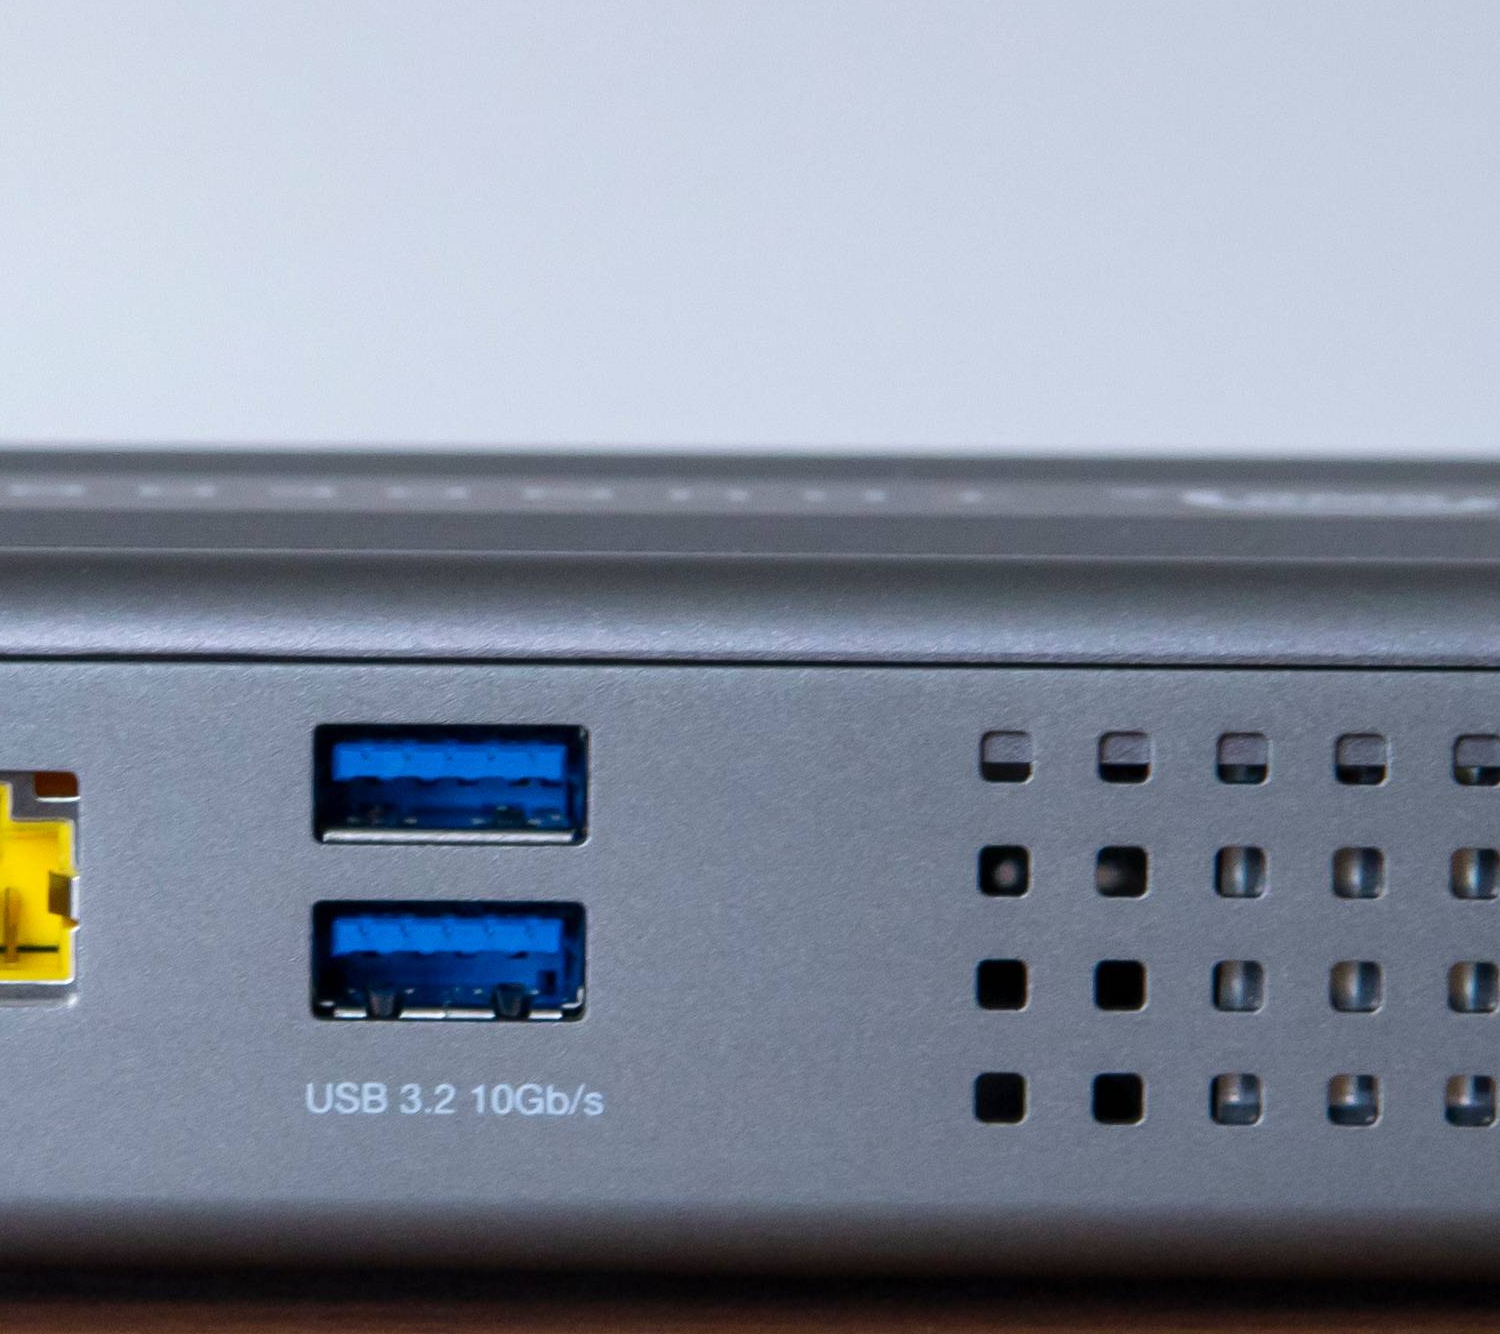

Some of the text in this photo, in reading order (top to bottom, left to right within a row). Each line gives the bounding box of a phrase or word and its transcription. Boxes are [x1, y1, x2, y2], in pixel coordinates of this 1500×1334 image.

[305, 1082, 605, 1115] USB 3.2 10Gb/s
